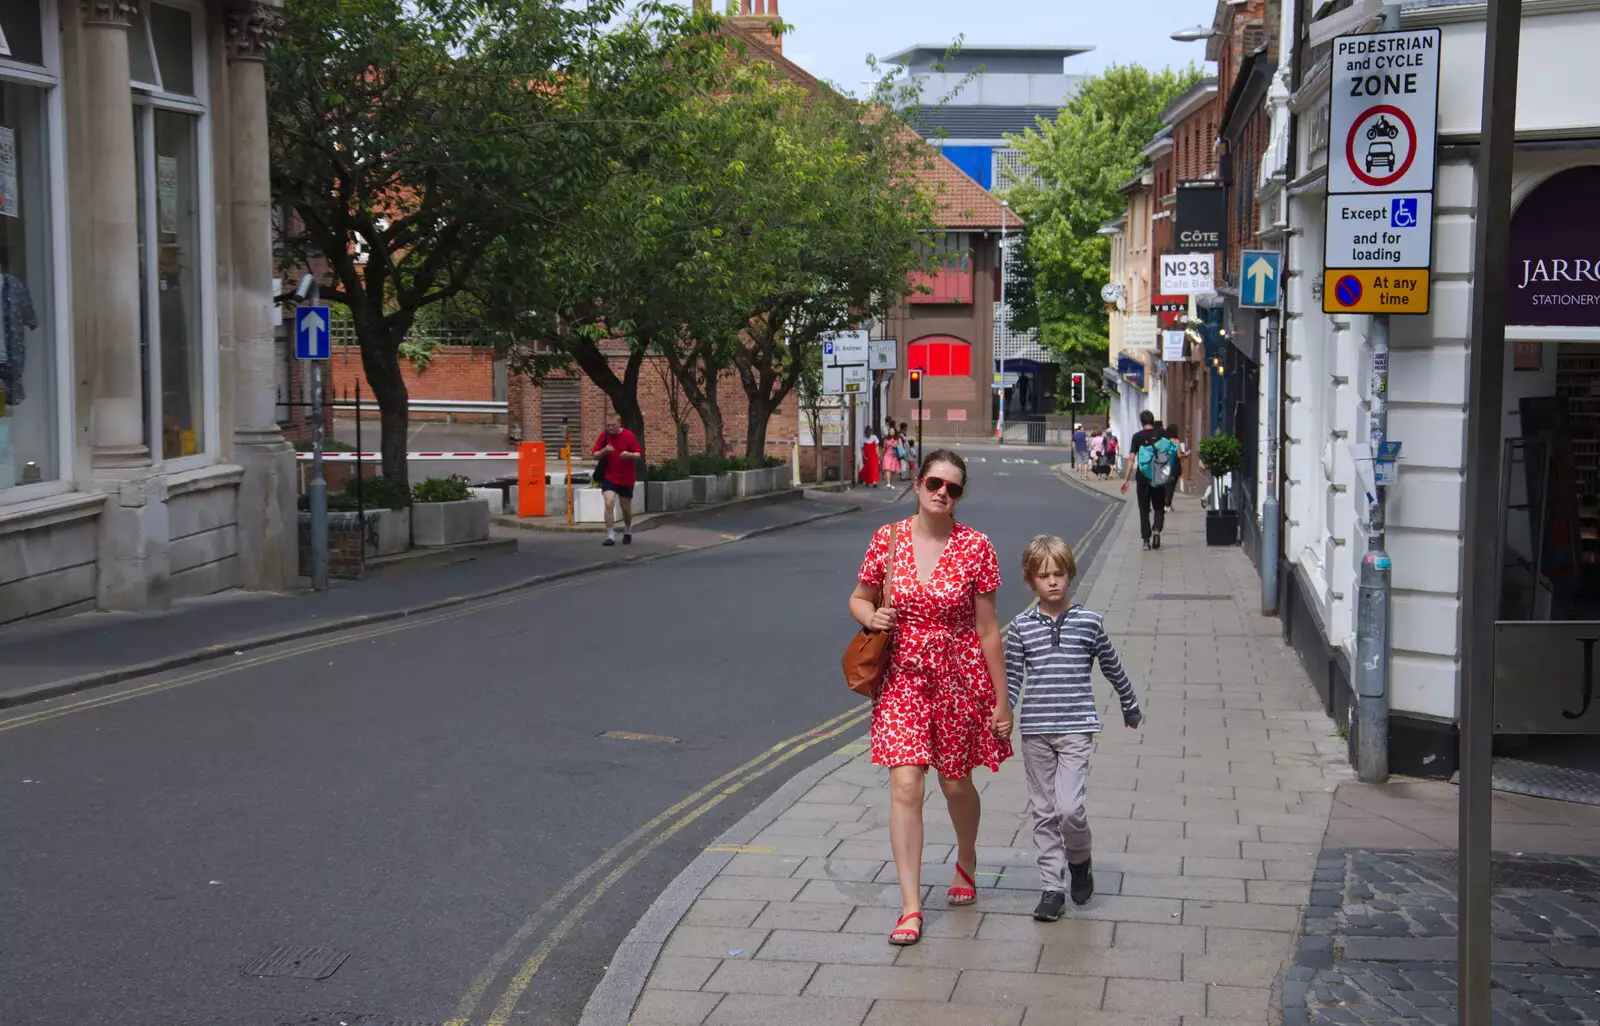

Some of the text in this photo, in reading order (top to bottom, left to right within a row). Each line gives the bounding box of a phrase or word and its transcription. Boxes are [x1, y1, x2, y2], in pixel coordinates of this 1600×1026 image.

[1338, 36, 1433, 55] PEDESTRIAN
[1346, 54, 1423, 71] and CYCLE
[1350, 73, 1417, 97] ZONE
[1341, 207, 1387, 221] Except
[1180, 230, 1219, 242] CÔTE
[1353, 232, 1401, 244] and for
[1352, 248, 1401, 262] loading
[1518, 259, 1600, 289] JARR
[1373, 276, 1417, 291] At any
[1379, 292, 1410, 305] time
[1532, 294, 1600, 306] STATIONERY
[1561, 638, 1600, 720] J
